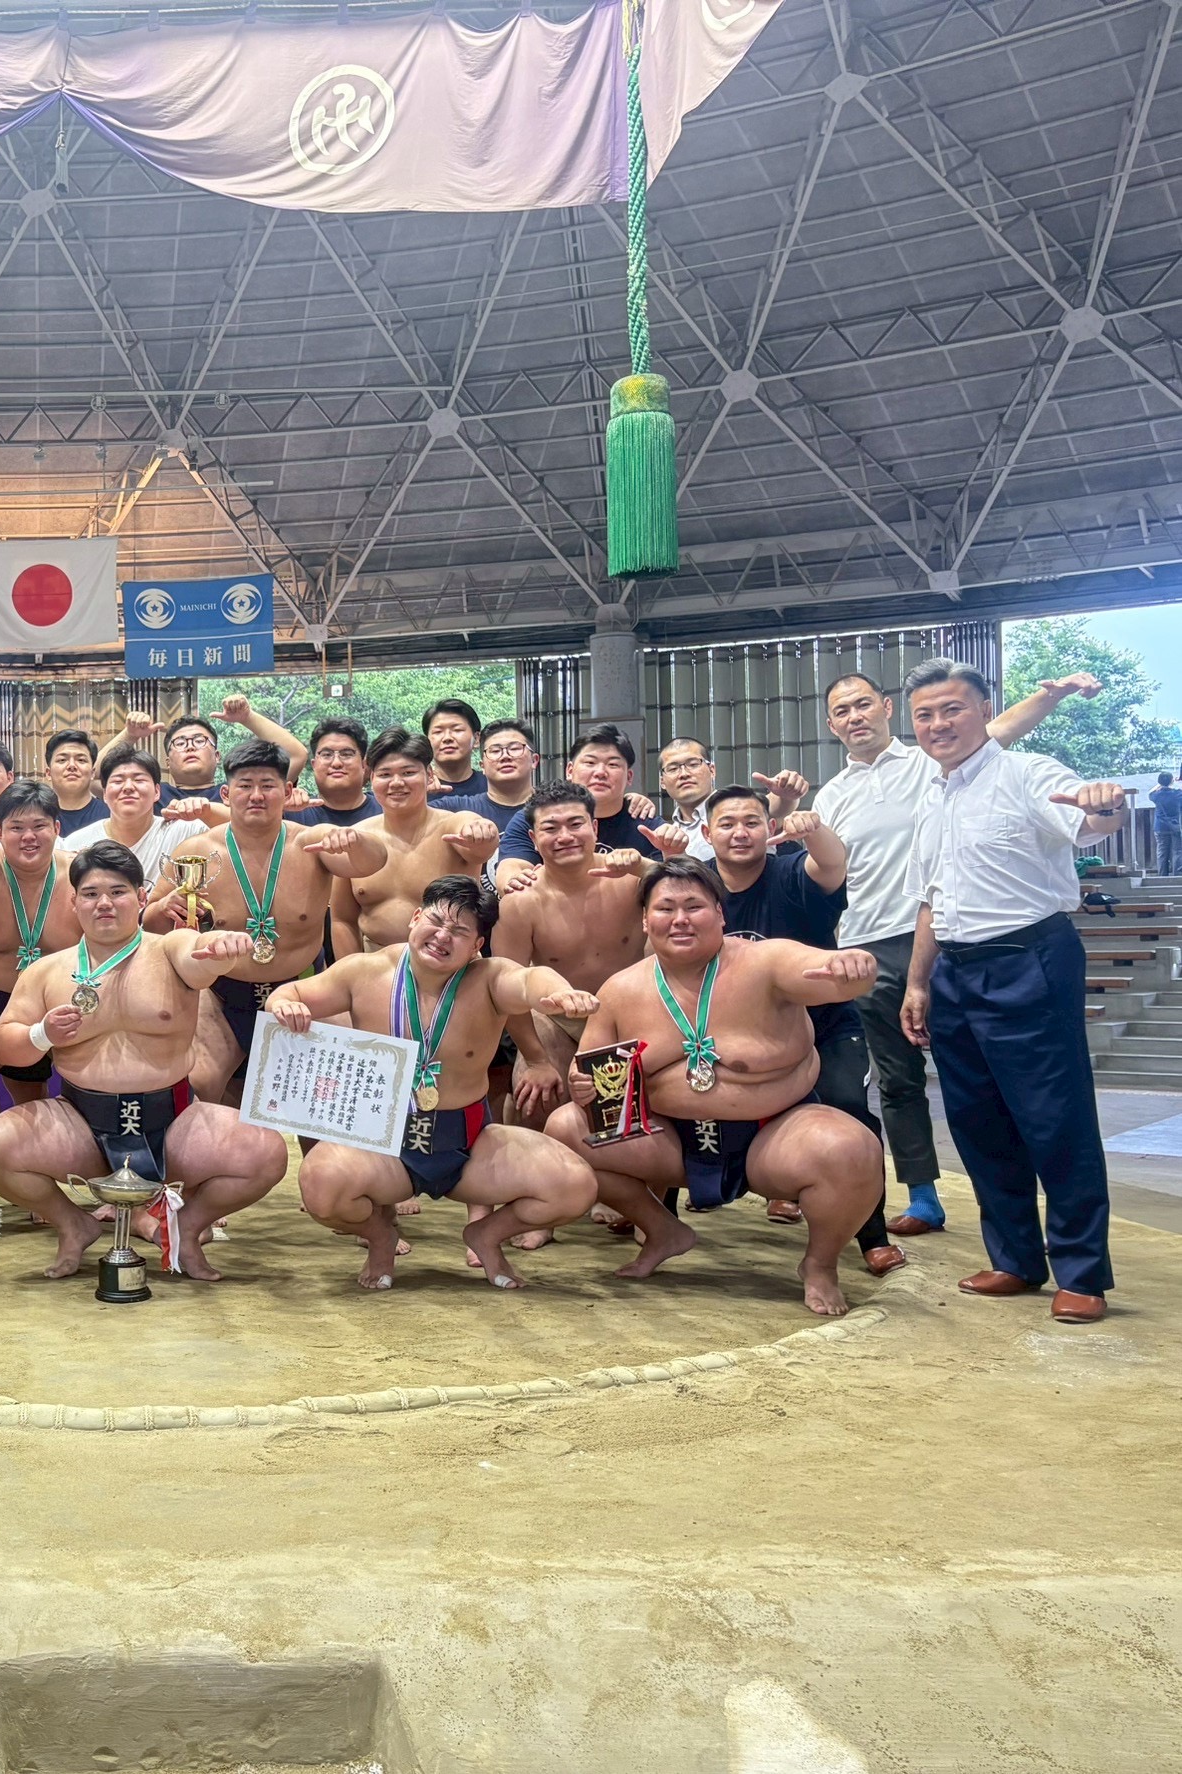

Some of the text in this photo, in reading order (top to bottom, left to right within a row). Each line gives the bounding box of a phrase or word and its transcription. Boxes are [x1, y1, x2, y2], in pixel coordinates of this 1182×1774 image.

[180, 603, 217, 612] MAINICHI
[148, 643, 252, 668] 毎日新聞
[370, 1074, 386, 1114] 表彰状
[120, 1100, 141, 1136] 近大
[408, 1115, 432, 1155] 近大
[695, 1120, 720, 1154] 近大
